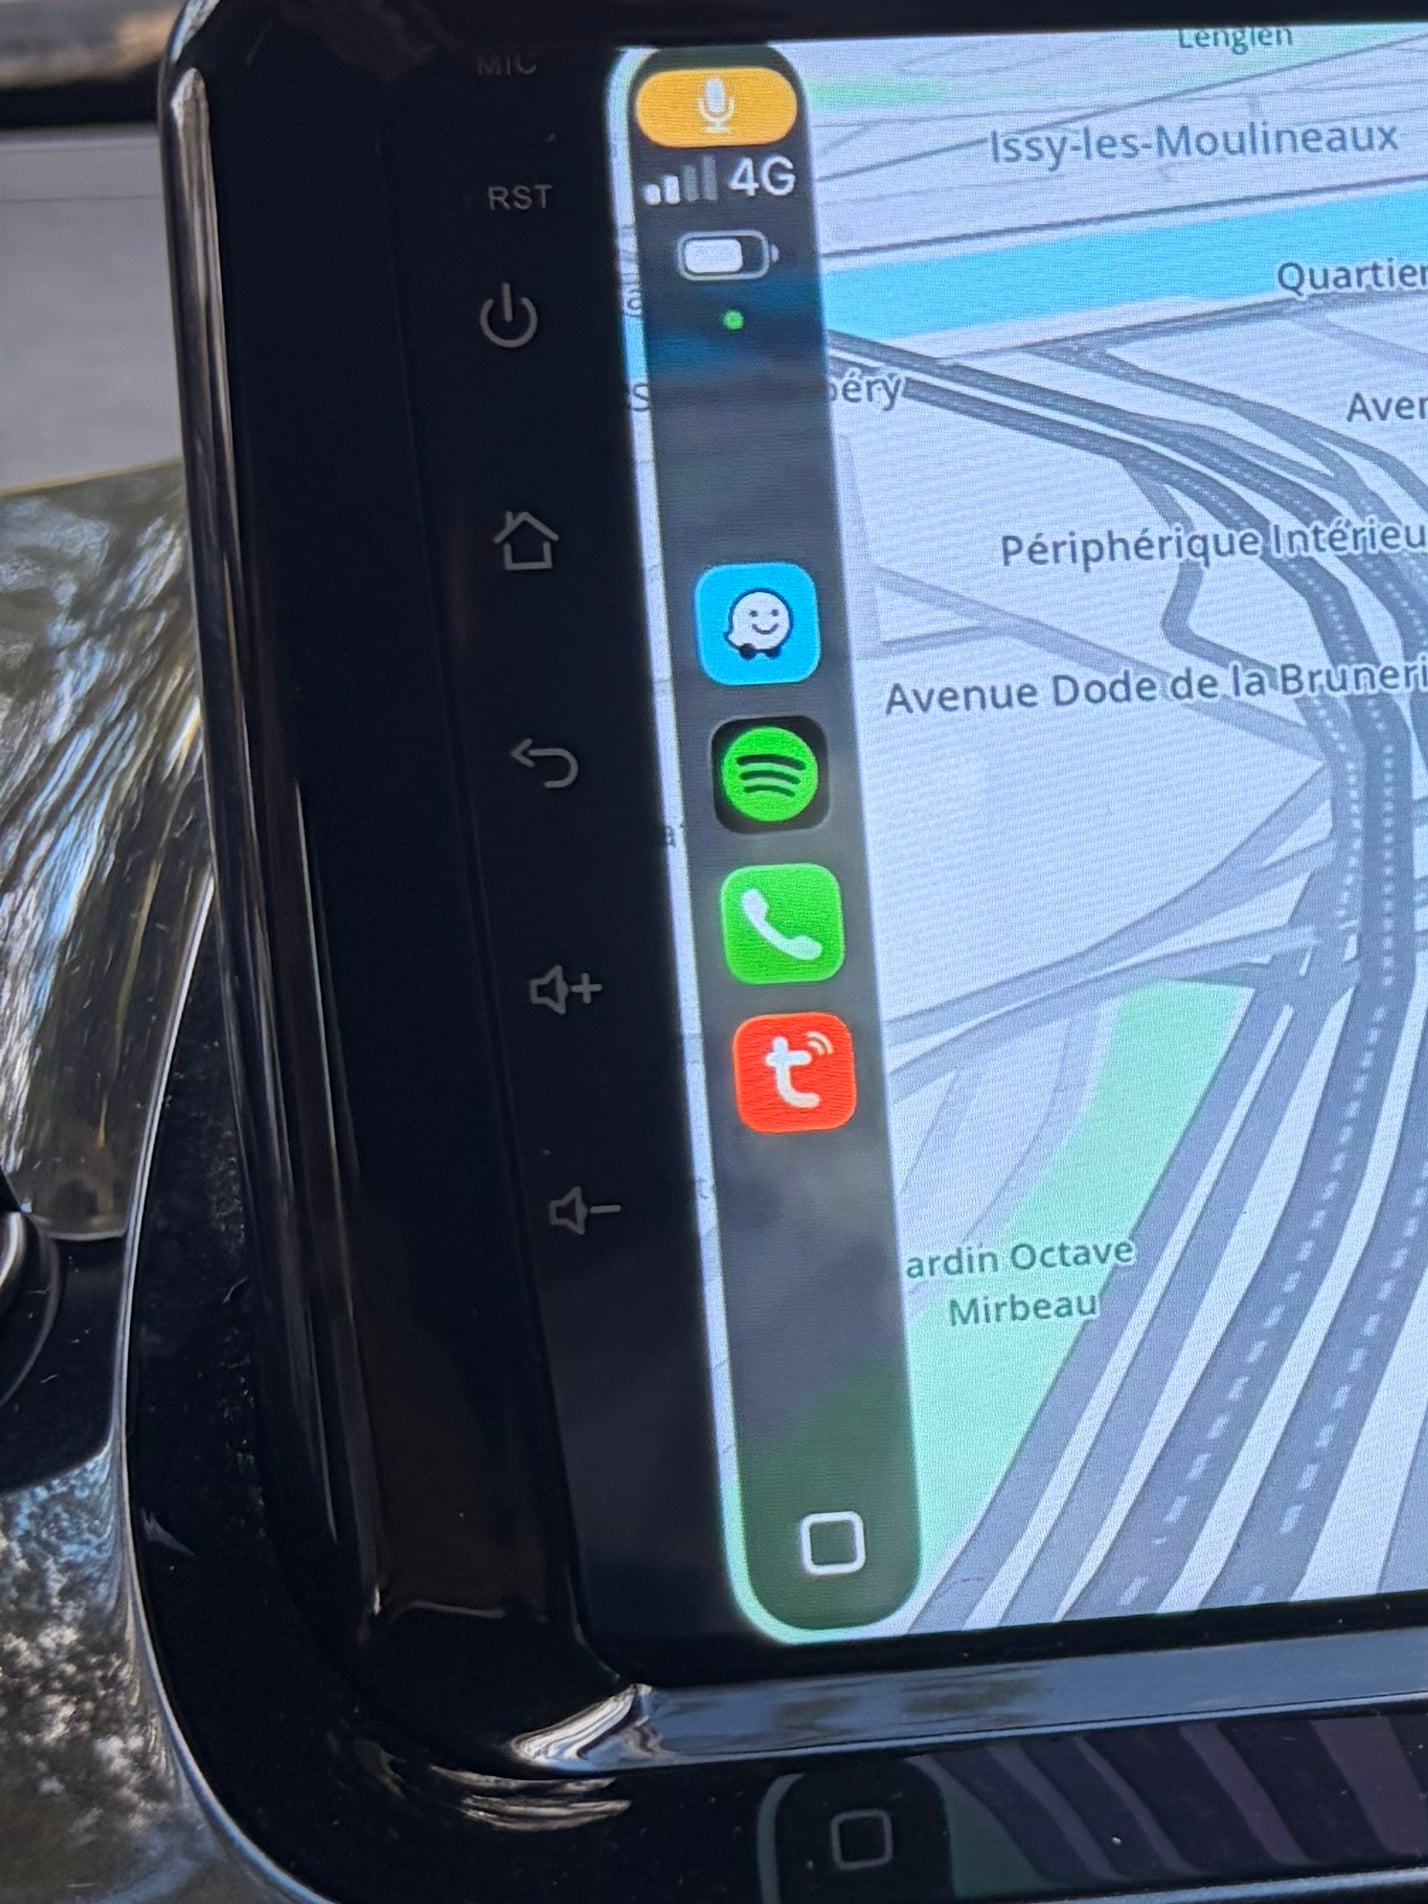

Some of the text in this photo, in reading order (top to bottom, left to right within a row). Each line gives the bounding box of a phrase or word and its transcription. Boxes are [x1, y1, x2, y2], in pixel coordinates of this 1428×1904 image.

[990, 121, 1400, 171] Issy-les-Moulineaux
[488, 183, 553, 211] RST
[728, 157, 796, 198] 4G
[1001, 526, 1261, 574] Périphérique
[885, 682, 1039, 716] Avenue
[1053, 670, 1158, 707] Dode
[1171, 667, 1218, 702] de
[1232, 664, 1266, 697] la
[1011, 1238, 1135, 1272] Octave
[950, 1292, 1098, 1328] Mirbeau
